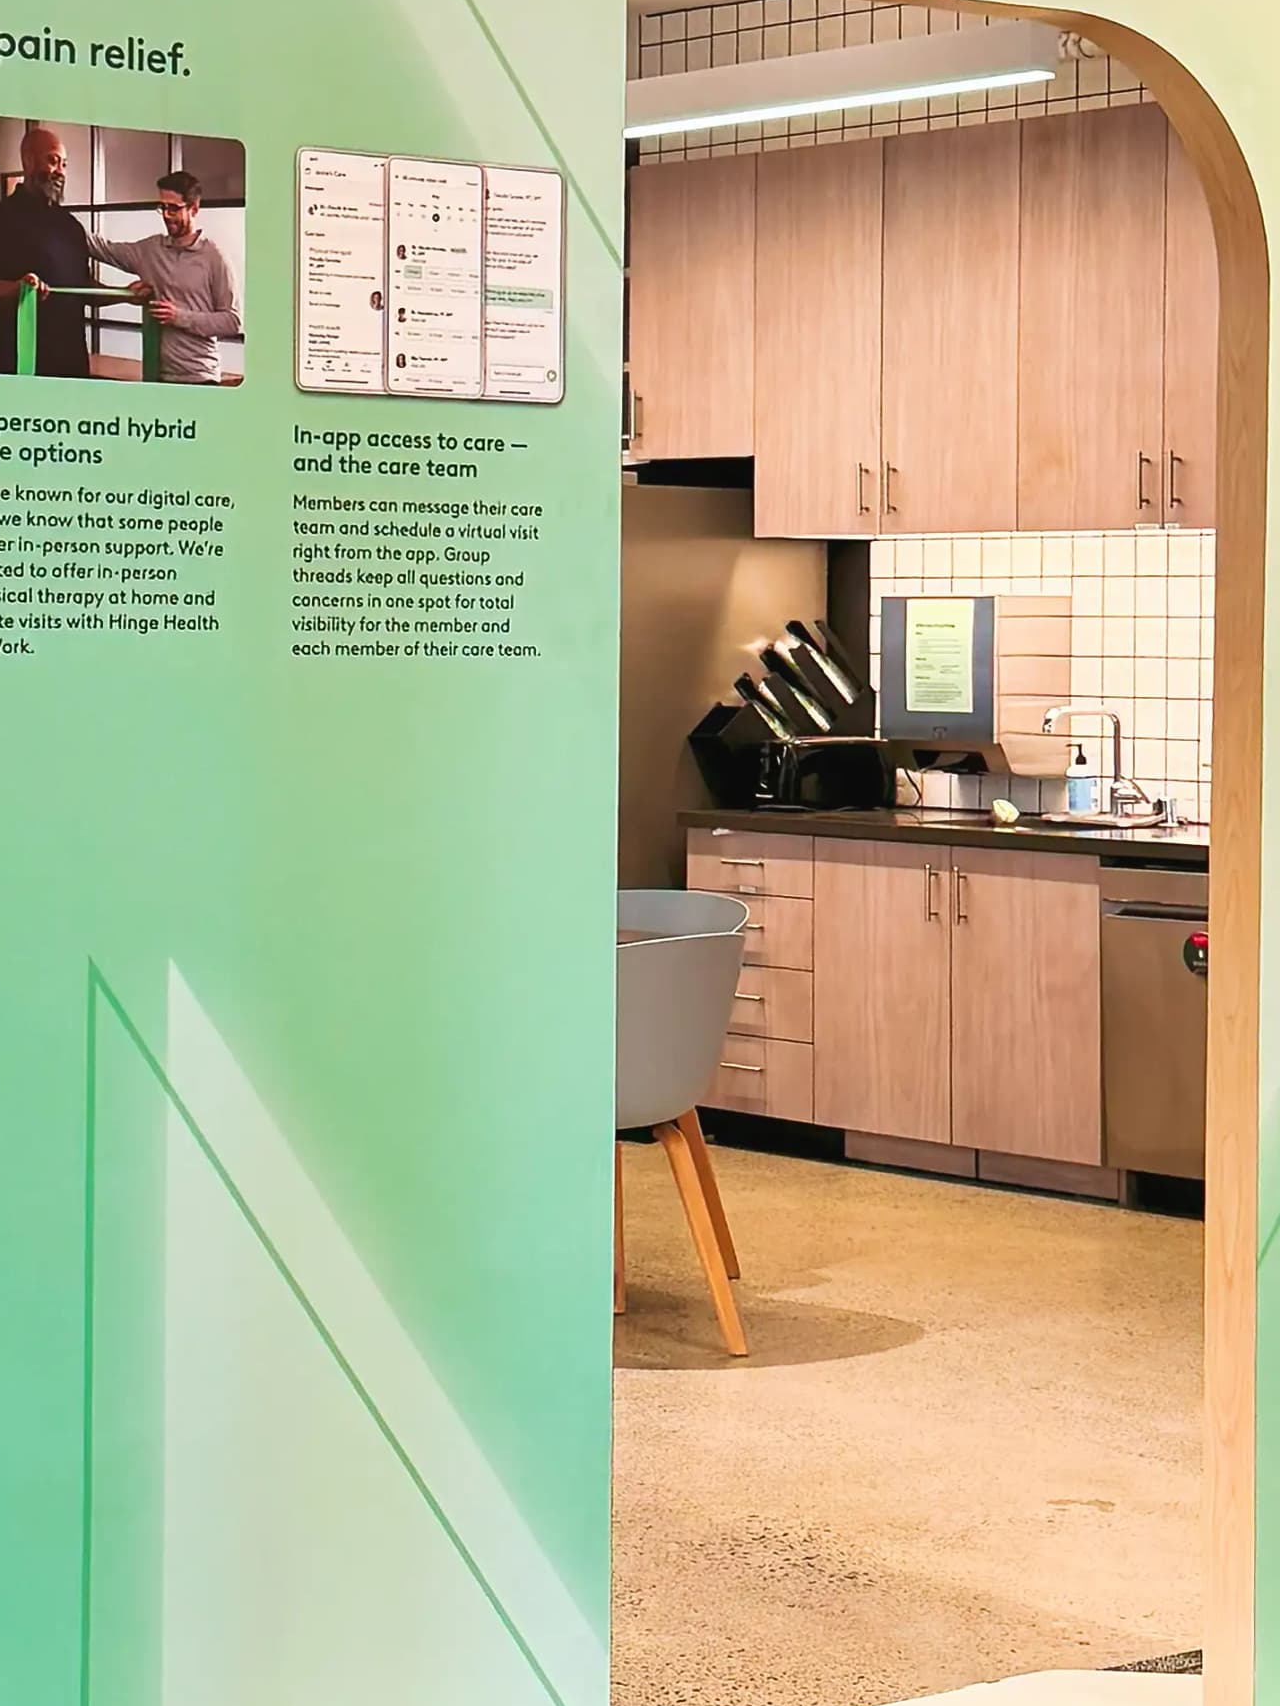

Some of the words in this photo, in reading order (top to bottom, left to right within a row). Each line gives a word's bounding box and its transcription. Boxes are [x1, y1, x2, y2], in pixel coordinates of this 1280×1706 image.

[90, 36, 191, 77] relief.
[77, 416, 121, 436] and
[127, 416, 196, 444] hybrid
[294, 424, 362, 452] In-app
[366, 433, 432, 450] access
[436, 432, 458, 451] to
[463, 437, 506, 453] care
[18, 441, 103, 468] options
[293, 453, 333, 473] and
[338, 453, 372, 474] the
[377, 460, 421, 476] care
[425, 459, 478, 478] team
[15, 484, 73, 502] known
[77, 486, 102, 504] for
[104, 492, 134, 505] our
[137, 488, 190, 510] digital
[194, 495, 235, 510] care,
[293, 494, 366, 512] Members
[368, 500, 398, 513] can
[402, 501, 470, 519] message
[472, 499, 507, 516] their
[510, 505, 543, 517] care
[26, 510, 74, 528] know
[77, 512, 114, 529] that
[118, 517, 164, 531] some
[168, 515, 224, 536] people
[293, 520, 335, 535] team
[338, 520, 370, 536] and
[373, 520, 442, 538] schedule
[444, 526, 455, 538] a
[458, 523, 506, 540] virtual
[509, 524, 539, 541] visit
[18, 535, 101, 558] in-person
[104, 541, 175, 560] support.
[178, 539, 224, 557] We're
[292, 542, 332, 564] right
[333, 542, 372, 560] from
[375, 545, 402, 561] the
[405, 549, 440, 566] app.
[443, 546, 491, 566] Group
[29, 562, 48, 579] to
[51, 561, 95, 580] offer
[97, 563, 177, 584] in-person
[292, 567, 353, 584] threads
[356, 567, 394, 589] keep
[396, 569, 416, 585] all
[419, 570, 492, 589] questions
[494, 571, 524, 587] and
[37, 587, 105, 609] therapy
[108, 590, 127, 605] at
[131, 588, 180, 606] home
[183, 589, 216, 606] and
[291, 595, 364, 608] concerns
[367, 592, 382, 609] in
[385, 596, 415, 609] one
[417, 595, 452, 613] spot
[454, 593, 477, 610] for
[479, 594, 514, 610] total
[18, 612, 62, 630] visits
[66, 612, 104, 630] with
[109, 613, 159, 635] Hinge
[163, 614, 220, 631] Health
[291, 615, 356, 637] visibility
[359, 615, 382, 632] for
[384, 616, 411, 633] the
[414, 617, 478, 633] member
[481, 617, 511, 633] and
[291, 640, 331, 656] each
[334, 640, 401, 657] member
[403, 640, 421, 657] of
[423, 640, 459, 657] their
[461, 645, 495, 657] care
[497, 643, 542, 657] team.
